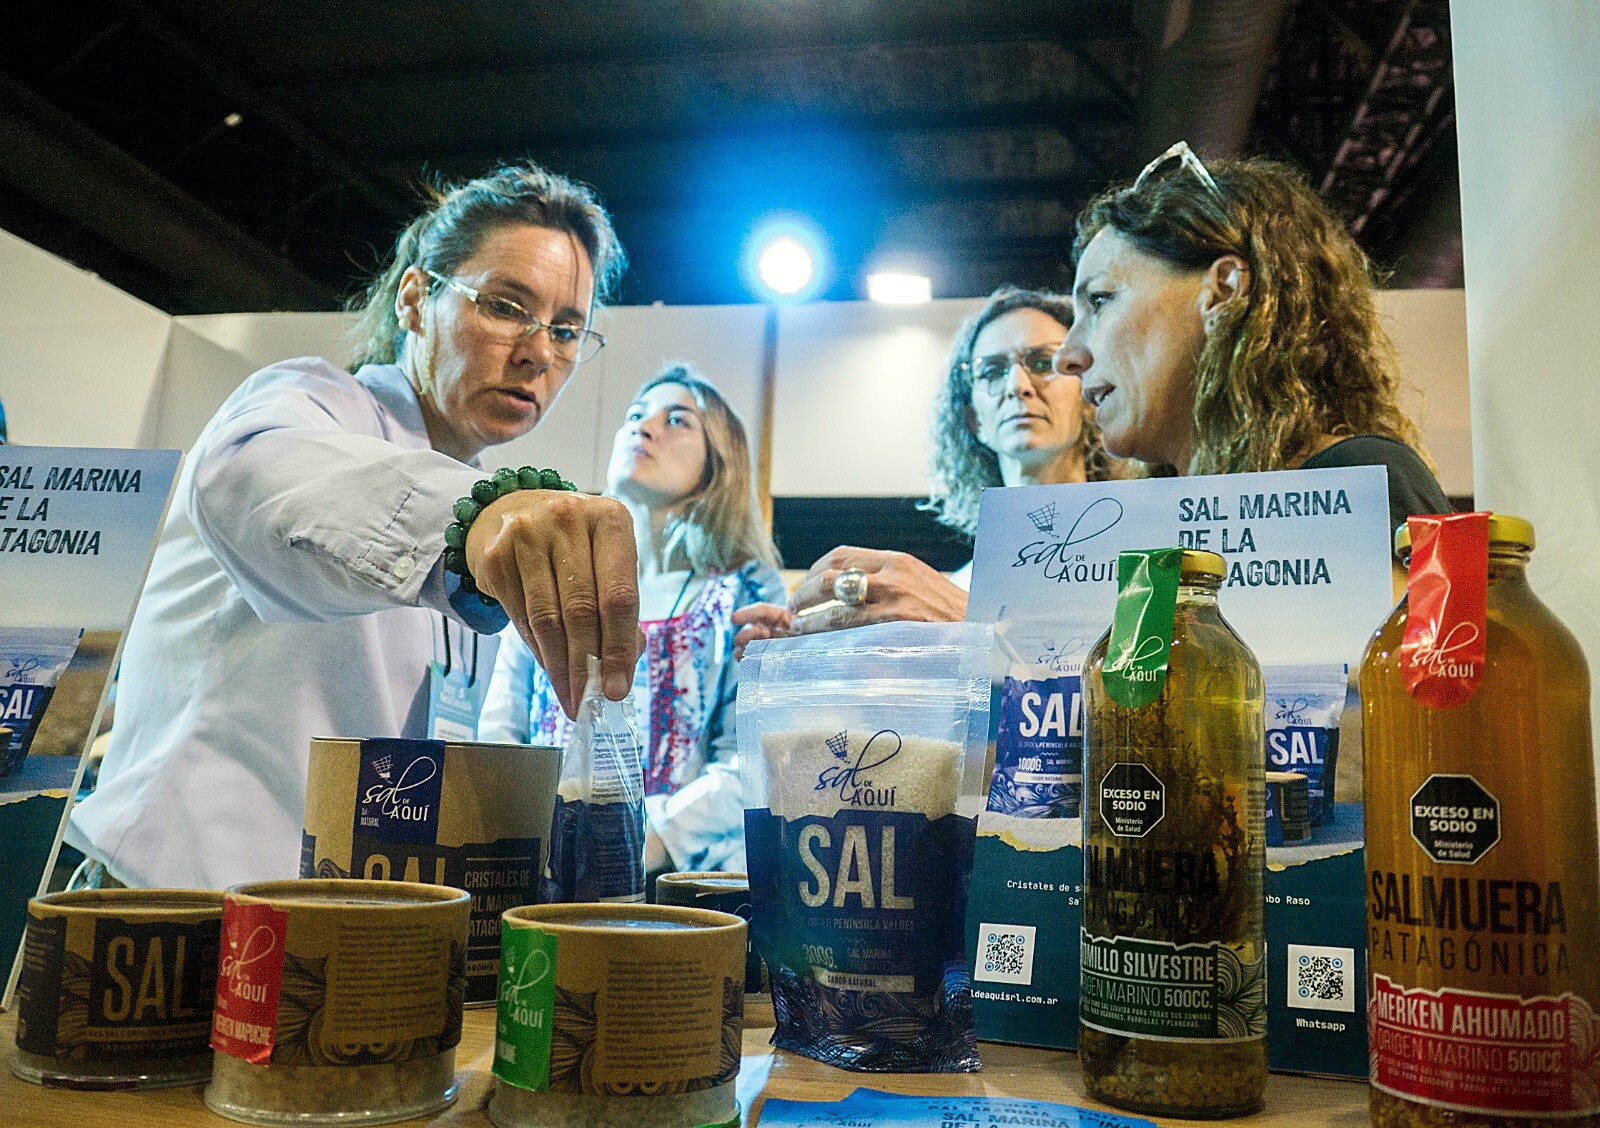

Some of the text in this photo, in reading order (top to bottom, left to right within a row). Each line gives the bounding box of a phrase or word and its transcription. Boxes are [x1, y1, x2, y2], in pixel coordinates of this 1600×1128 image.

[0, 465, 141, 493] SAL MARINA
[0, 496, 49, 521] E LA
[1179, 489, 1352, 521] SAL MARINA
[0, 527, 101, 555] TAGONIA
[1011, 498, 1123, 579] sal
[1223, 528, 1256, 553] LA
[1058, 560, 1117, 583] AQUÍ
[1228, 558, 1331, 587] AGONIA
[1019, 692, 1082, 738] SAL
[1270, 731, 1325, 765] SAL
[814, 729, 902, 802] sal
[362, 755, 437, 816] sal
[851, 786, 897, 807] AQUÍ
[1103, 788, 1160, 800] EXCESO EN
[391, 804, 430, 822] AQUÍ
[1112, 801, 1147, 811] SODIO
[1414, 805, 1494, 821] EXCESO EN
[1115, 816, 1143, 825] Ministerio
[1117, 824, 1141, 833] de Salud
[1429, 820, 1477, 833] SODIO
[1434, 839, 1473, 850] Ministerio
[1437, 849, 1471, 859] de Salud
[799, 824, 915, 909] SAL
[464, 870, 519, 888] CRISTALES
[520, 870, 531, 886] DE
[1007, 880, 1054, 892] Cristales
[1059, 883, 1069, 892] de
[472, 896, 484, 912] AL
[1068, 896, 1082, 906] Sa
[1286, 895, 1311, 906] Raso
[1371, 869, 1568, 935] SALMUERA
[1372, 926, 1571, 977] PATAGÓNICA
[1123, 950, 1214, 981] SILVESTRE
[103, 936, 194, 1022] SAL
[848, 976, 877, 988] NATURAL
[970, 989, 1059, 1006] ldeaquisrl.com.ar
[1106, 981, 1160, 1007] MARINO
[1164, 988, 1213, 1009] 500CC.
[1132, 1008, 1147, 1017] PARA
[1296, 1017, 1346, 1032] Whatsapp
[1378, 990, 1566, 1041] MERKEN AHUMADO
[1427, 1041, 1503, 1072] MARINO
